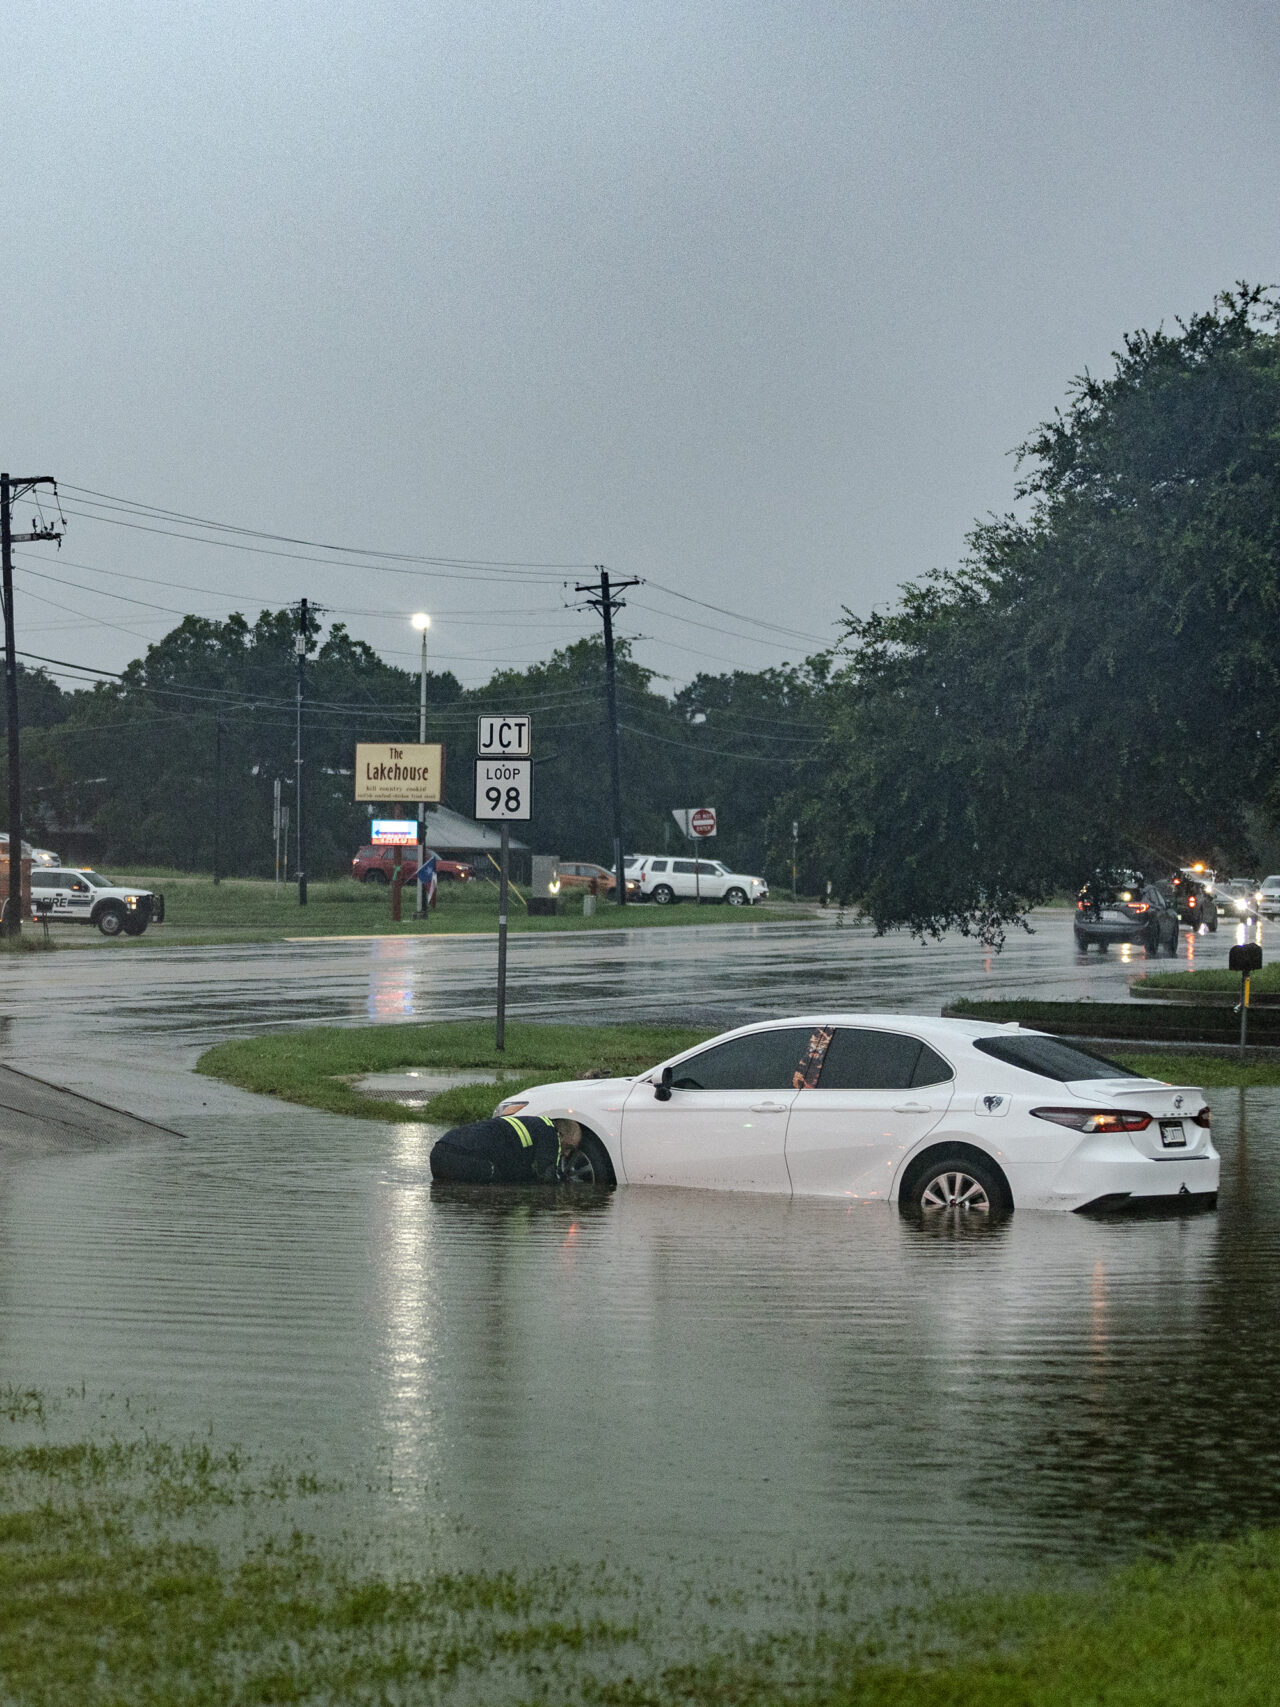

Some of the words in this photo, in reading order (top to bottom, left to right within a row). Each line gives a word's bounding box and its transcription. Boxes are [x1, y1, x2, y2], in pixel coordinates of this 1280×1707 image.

[482, 722, 527, 749] JCT
[389, 748, 404, 760] The
[366, 762, 429, 781] Lakehouse
[486, 768, 521, 780] LOOP
[485, 786, 521, 813] 98
